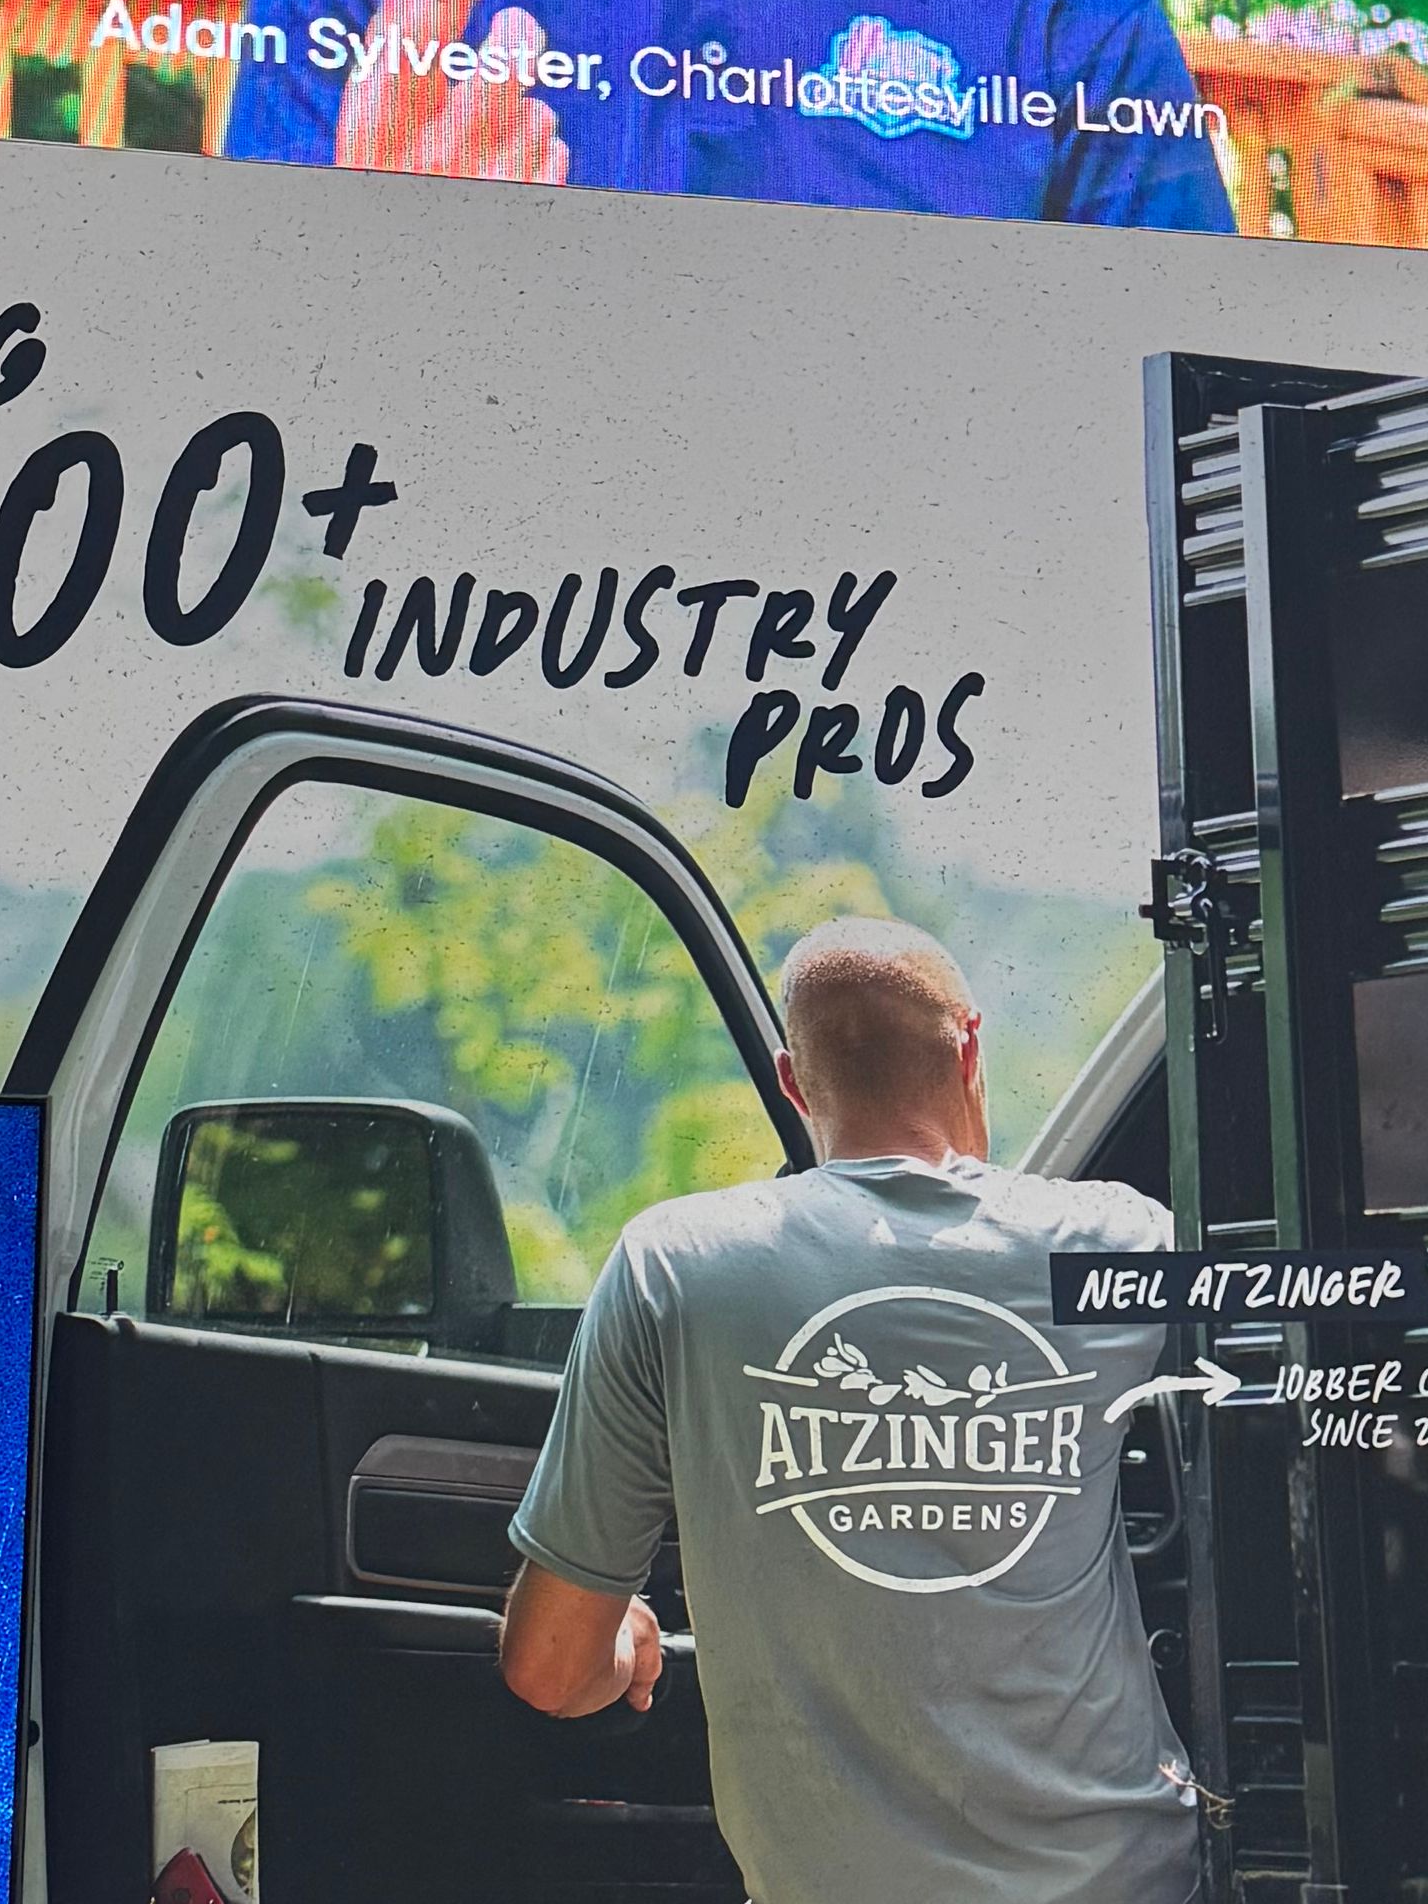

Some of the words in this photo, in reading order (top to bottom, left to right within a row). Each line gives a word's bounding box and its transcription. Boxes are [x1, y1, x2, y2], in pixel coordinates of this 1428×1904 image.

[307, 15, 615, 103] Sylvester,
[629, 43, 1058, 129] Charlottesville
[1076, 80, 1230, 141] Lawn
[344, 569, 899, 694] INDUSTRY
[724, 670, 988, 809] PROS
[1075, 1267, 1169, 1314] NEIL
[1188, 1261, 1410, 1312] ATZINGER
[1270, 1361, 1405, 1404] JOBBER
[754, 1402, 1086, 1489] ATZINGER
[1301, 1412, 1396, 1451] SINCE
[828, 1499, 1030, 1534] GARDENS
